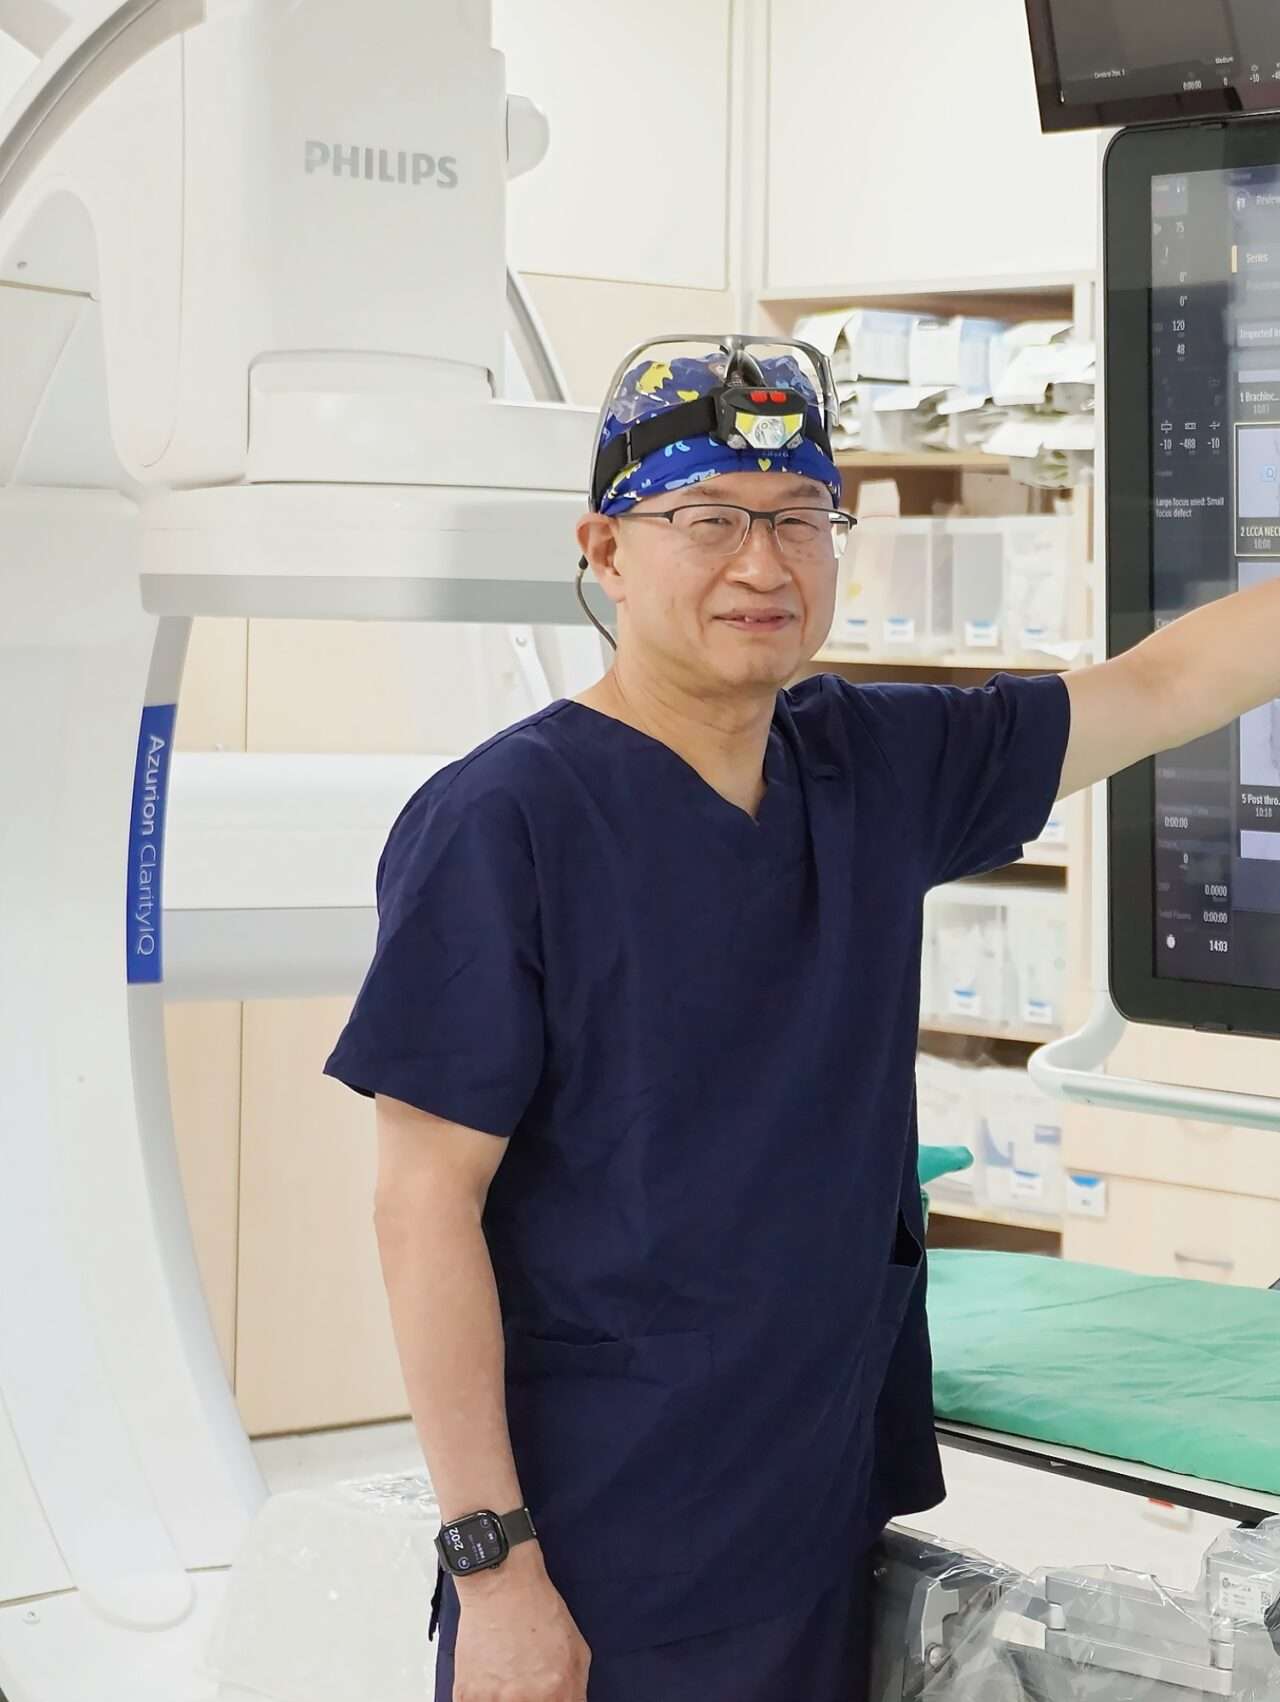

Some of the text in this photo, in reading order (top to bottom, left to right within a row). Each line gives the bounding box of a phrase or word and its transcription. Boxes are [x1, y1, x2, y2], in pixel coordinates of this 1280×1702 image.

[304, 140, 459, 189] PHILIPS
[1246, 253, 1269, 265] Series
[1172, 320, 1185, 331] 120
[1160, 439, 1172, 450] -10
[1207, 437, 1220, 449] -10
[1240, 526, 1245, 537] 2
[1246, 526, 1264, 537] LCCA
[1242, 793, 1247, 804] 5
[1248, 794, 1262, 805] Post
[136, 735, 165, 956] Azurion ClarityIQ
[1209, 939, 1228, 953] 14:03
